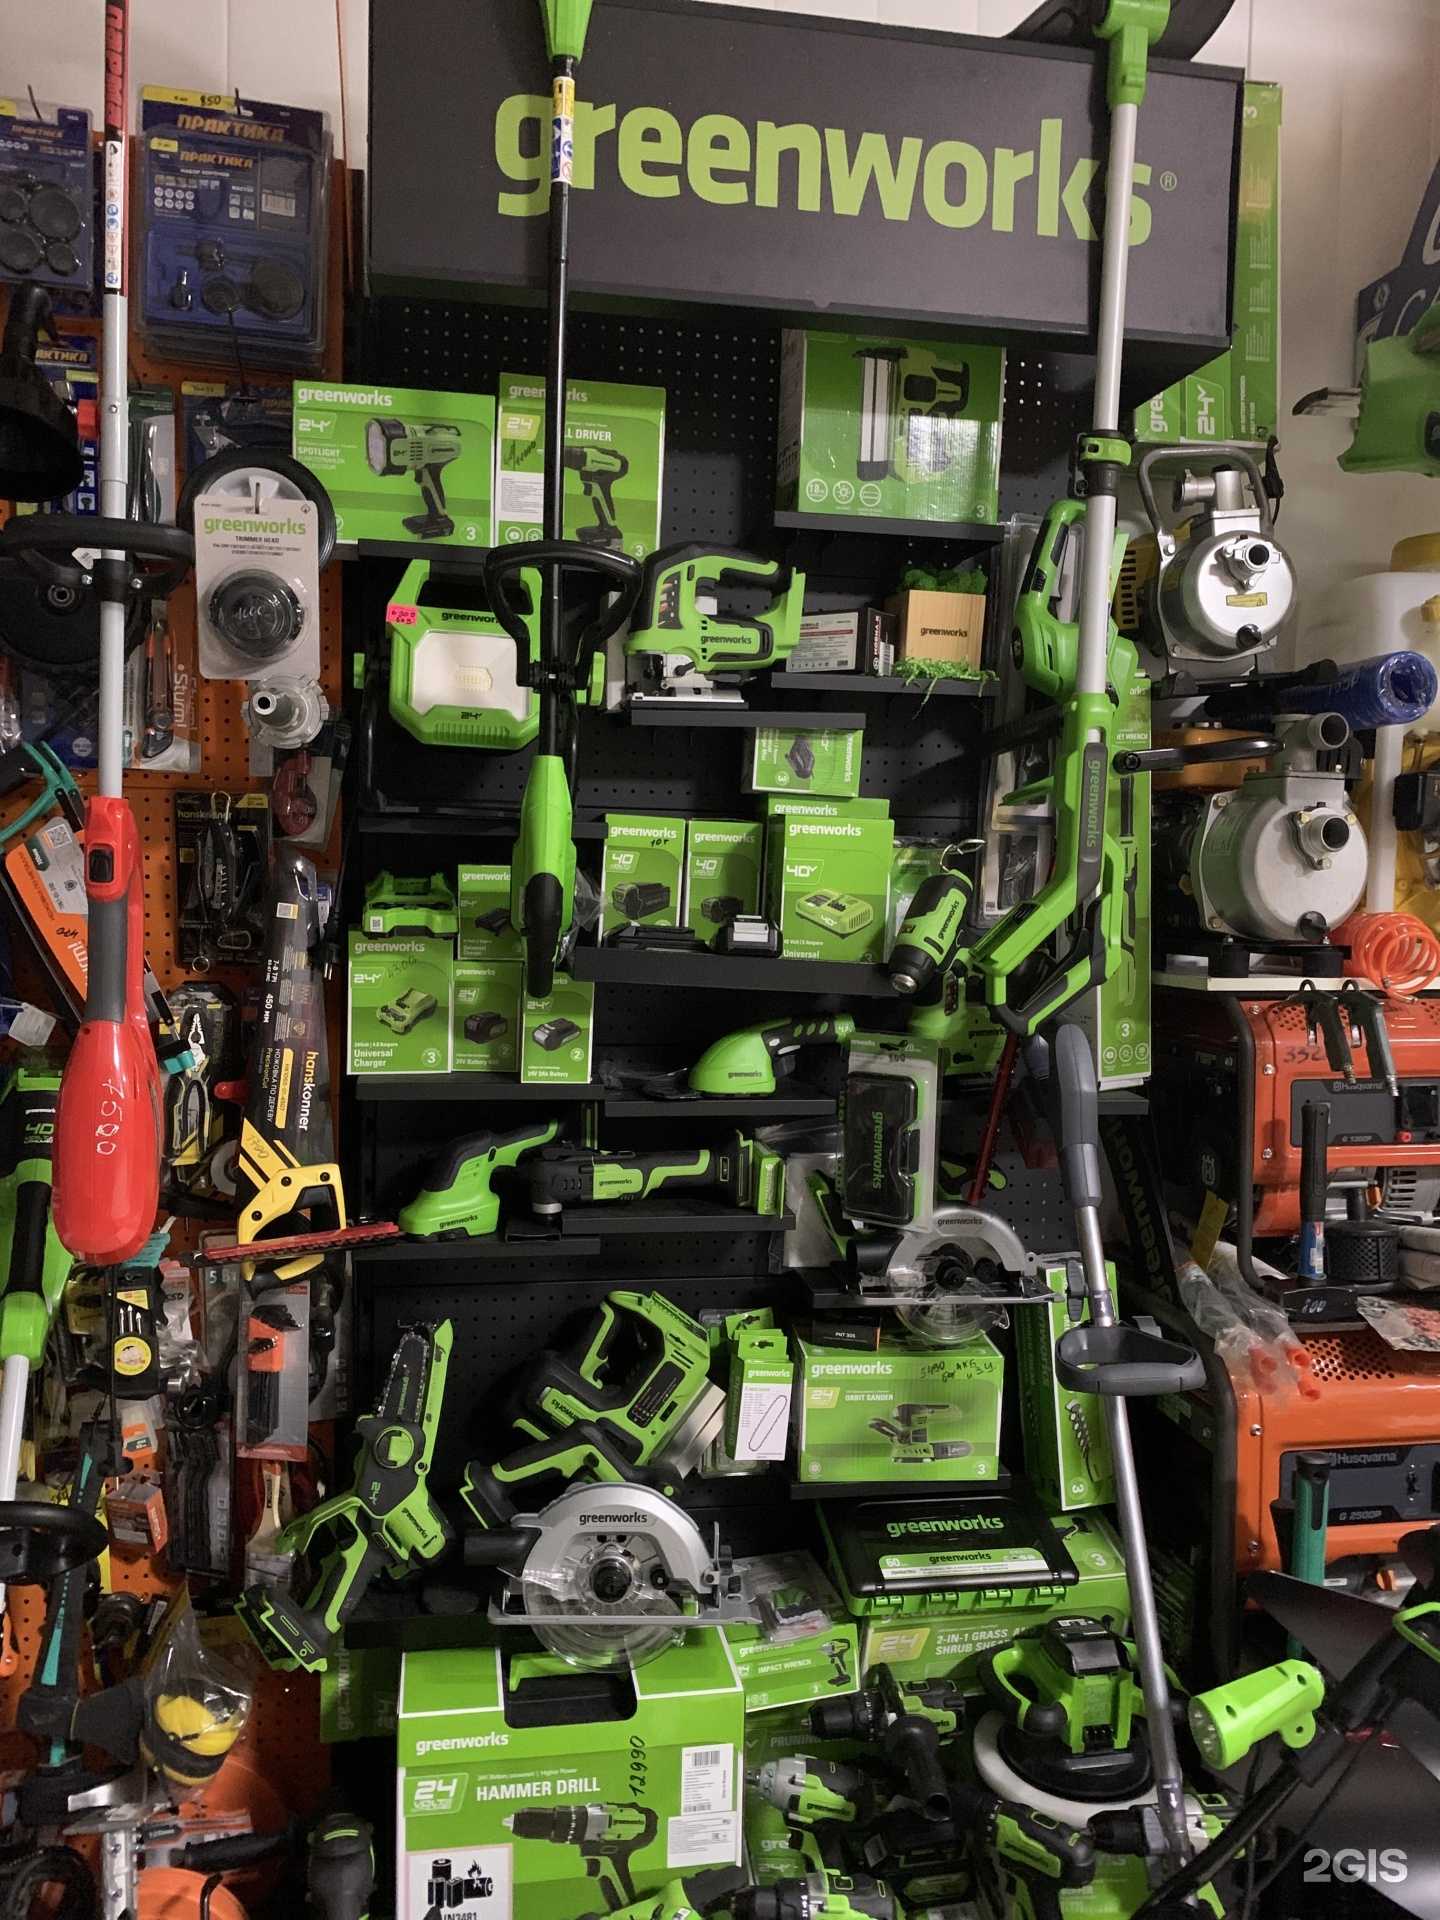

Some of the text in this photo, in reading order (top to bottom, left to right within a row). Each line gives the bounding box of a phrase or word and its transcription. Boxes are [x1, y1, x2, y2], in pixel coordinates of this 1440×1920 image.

[177, 113, 285, 142] ПРАКТИКА
[180, 151, 253, 168] ПРАКТИКА
[495, 95, 1152, 246] greenworks
[298, 386, 392, 407] greenworks
[510, 384, 588, 402] greenrks
[575, 430, 612, 443] DRIVER
[204, 517, 306, 536] greenworks
[466, 526, 476, 541] 3
[441, 610, 500, 624] greenwor
[921, 626, 968, 638] greenworks
[700, 634, 752, 646] greenworks
[172, 673, 189, 728] Sturm!
[774, 802, 838, 816] greenworks
[1087, 759, 1100, 848] greenworks
[610, 825, 677, 839] greenworks
[789, 823, 862, 837] greenworks
[694, 831, 755, 844] greenworks
[612, 853, 634, 865] 40
[695, 860, 717, 871] 40
[355, 941, 425, 955] greenworks
[783, 949, 820, 959] Universal
[455, 968, 495, 977] greenworks
[1121, 1023, 1130, 1037] 3
[354, 1048, 393, 1058] Universal
[426, 1051, 437, 1063] 3
[573, 1050, 581, 1059] 2
[354, 1058, 387, 1069] Charger
[727, 1070, 763, 1080] greenworks
[266, 1048, 280, 1123] НОЖОВКА ПО ДЕРЕВУ
[298, 1051, 320, 1131] hanskonner
[871, 1111, 883, 1189] greenworks
[599, 1176, 633, 1188] greenworks
[439, 1213, 478, 1230] greenworks
[937, 1216, 983, 1227] greenworks
[747, 1368, 790, 1379] greenworks
[811, 1362, 893, 1377] greenworks
[1337, 1452, 1397, 1465] Husqvarna
[976, 1463, 986, 1475] 3
[1071, 1484, 1084, 1494] 3
[402, 1508, 428, 1540] greenworks
[579, 1512, 648, 1526] greenworks
[886, 1514, 1005, 1538] greenworks
[929, 1552, 992, 1565] greenworks
[1093, 1553, 1106, 1567] 3
[936, 1632, 969, 1645] 2-IN-1
[971, 1629, 1008, 1642] GRASS
[935, 1643, 974, 1656] SHRUB
[757, 1658, 812, 1675] IMPACT WRENCH
[415, 1731, 509, 1756] greenworks
[625, 1734, 648, 1796] 12990
[414, 1778, 458, 1800] 24
[476, 1781, 552, 1802] HAMMER
[556, 1776, 601, 1796] DRILL
